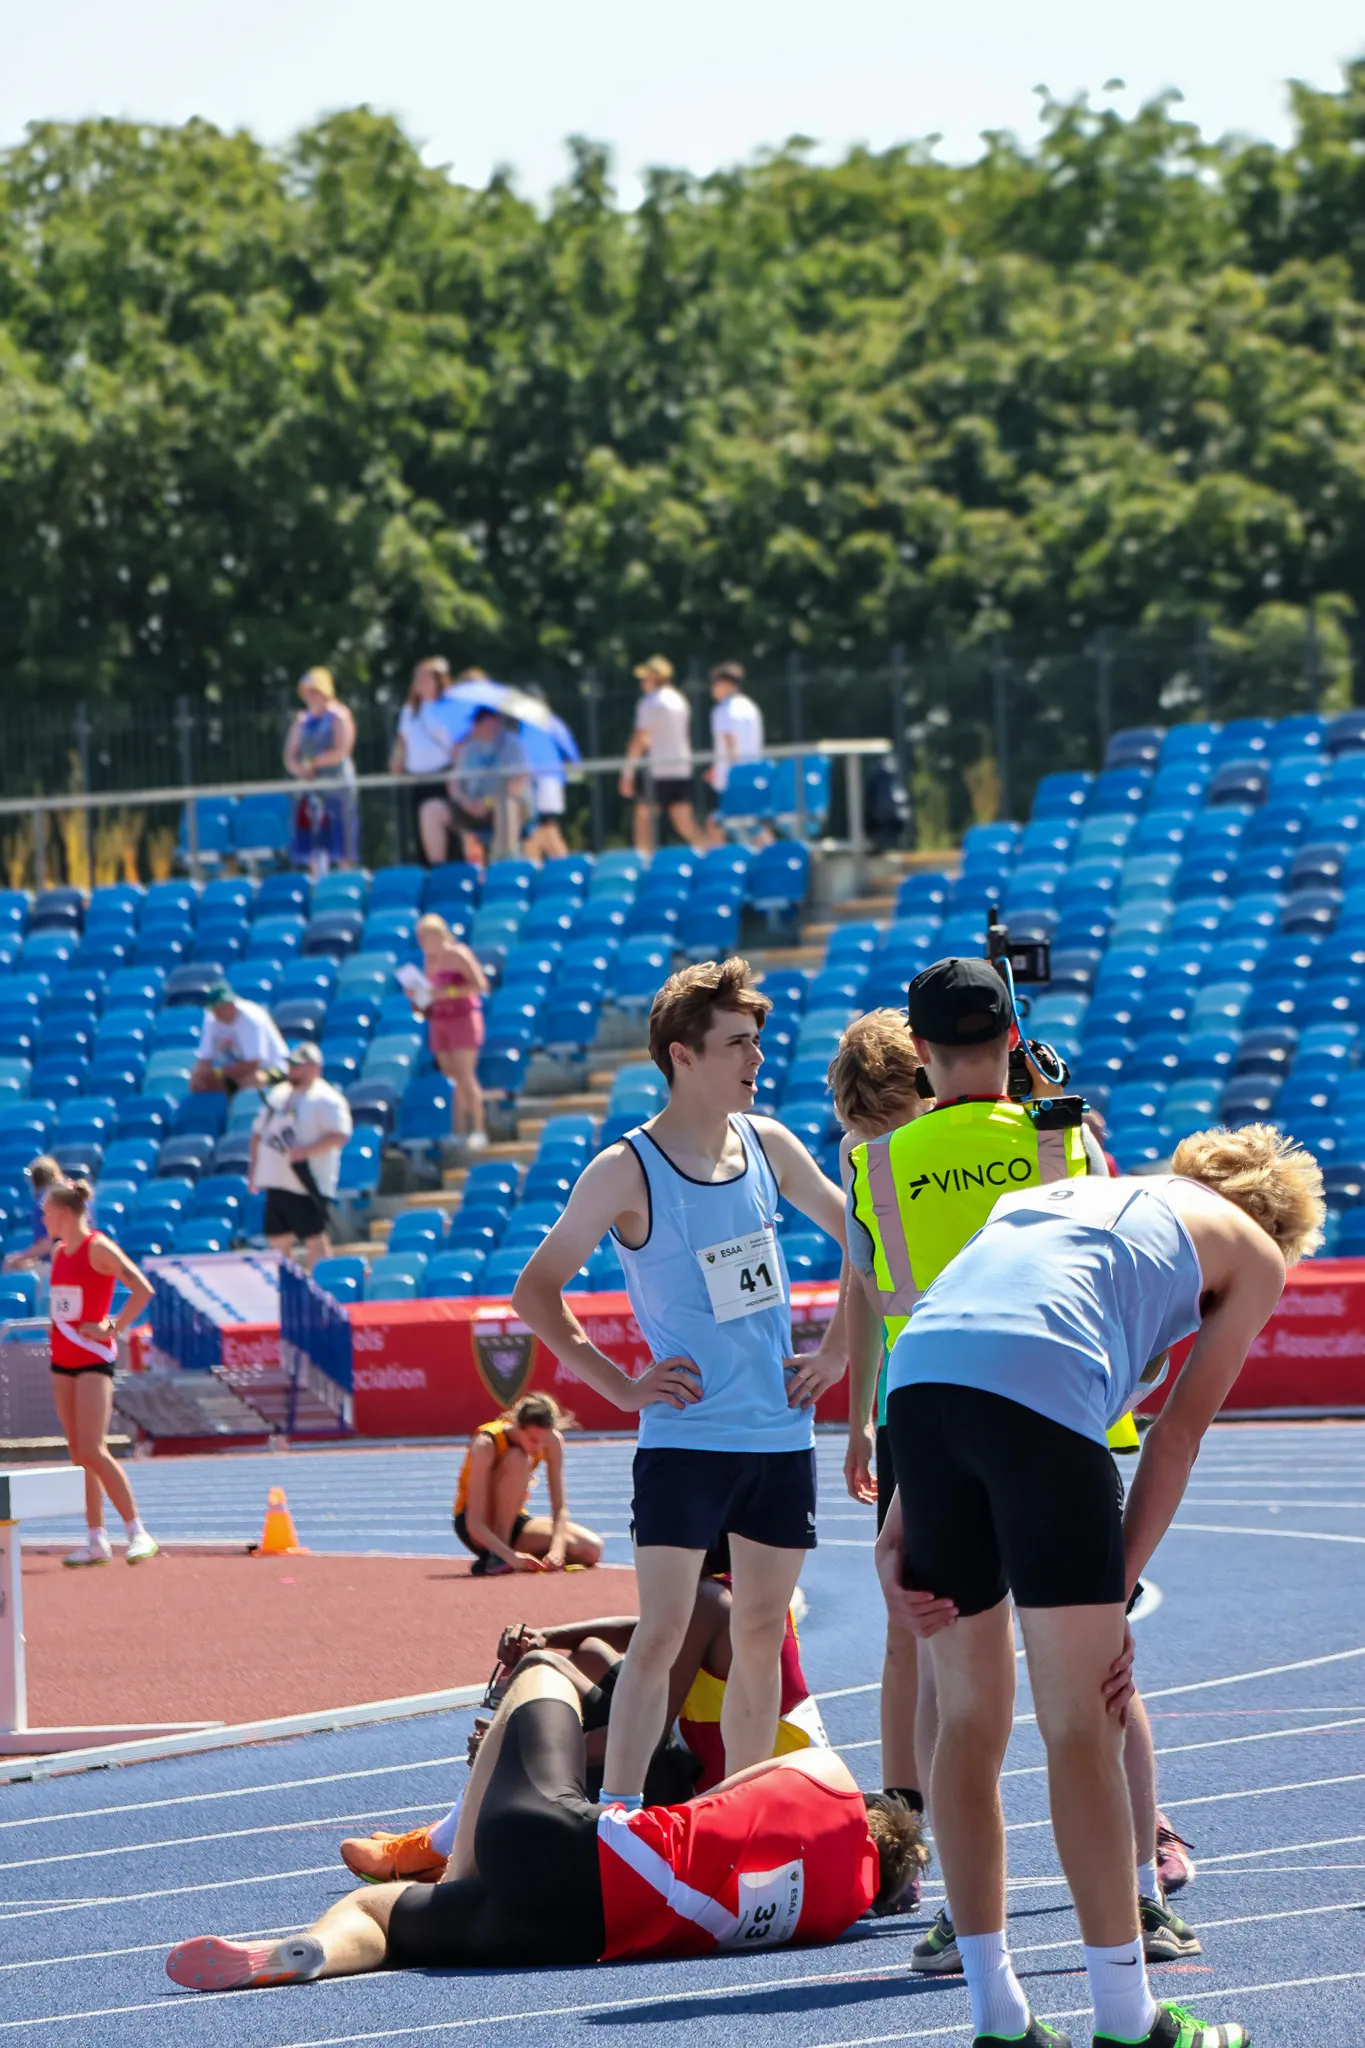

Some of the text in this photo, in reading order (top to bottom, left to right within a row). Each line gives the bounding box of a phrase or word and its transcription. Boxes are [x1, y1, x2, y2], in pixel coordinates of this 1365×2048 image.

[931, 1157, 1032, 1194] VINCO
[720, 1245, 743, 1259] ESAA
[739, 1262, 774, 1293] 41
[787, 1888, 798, 1917] ESAA
[744, 1902, 777, 1939] 33
